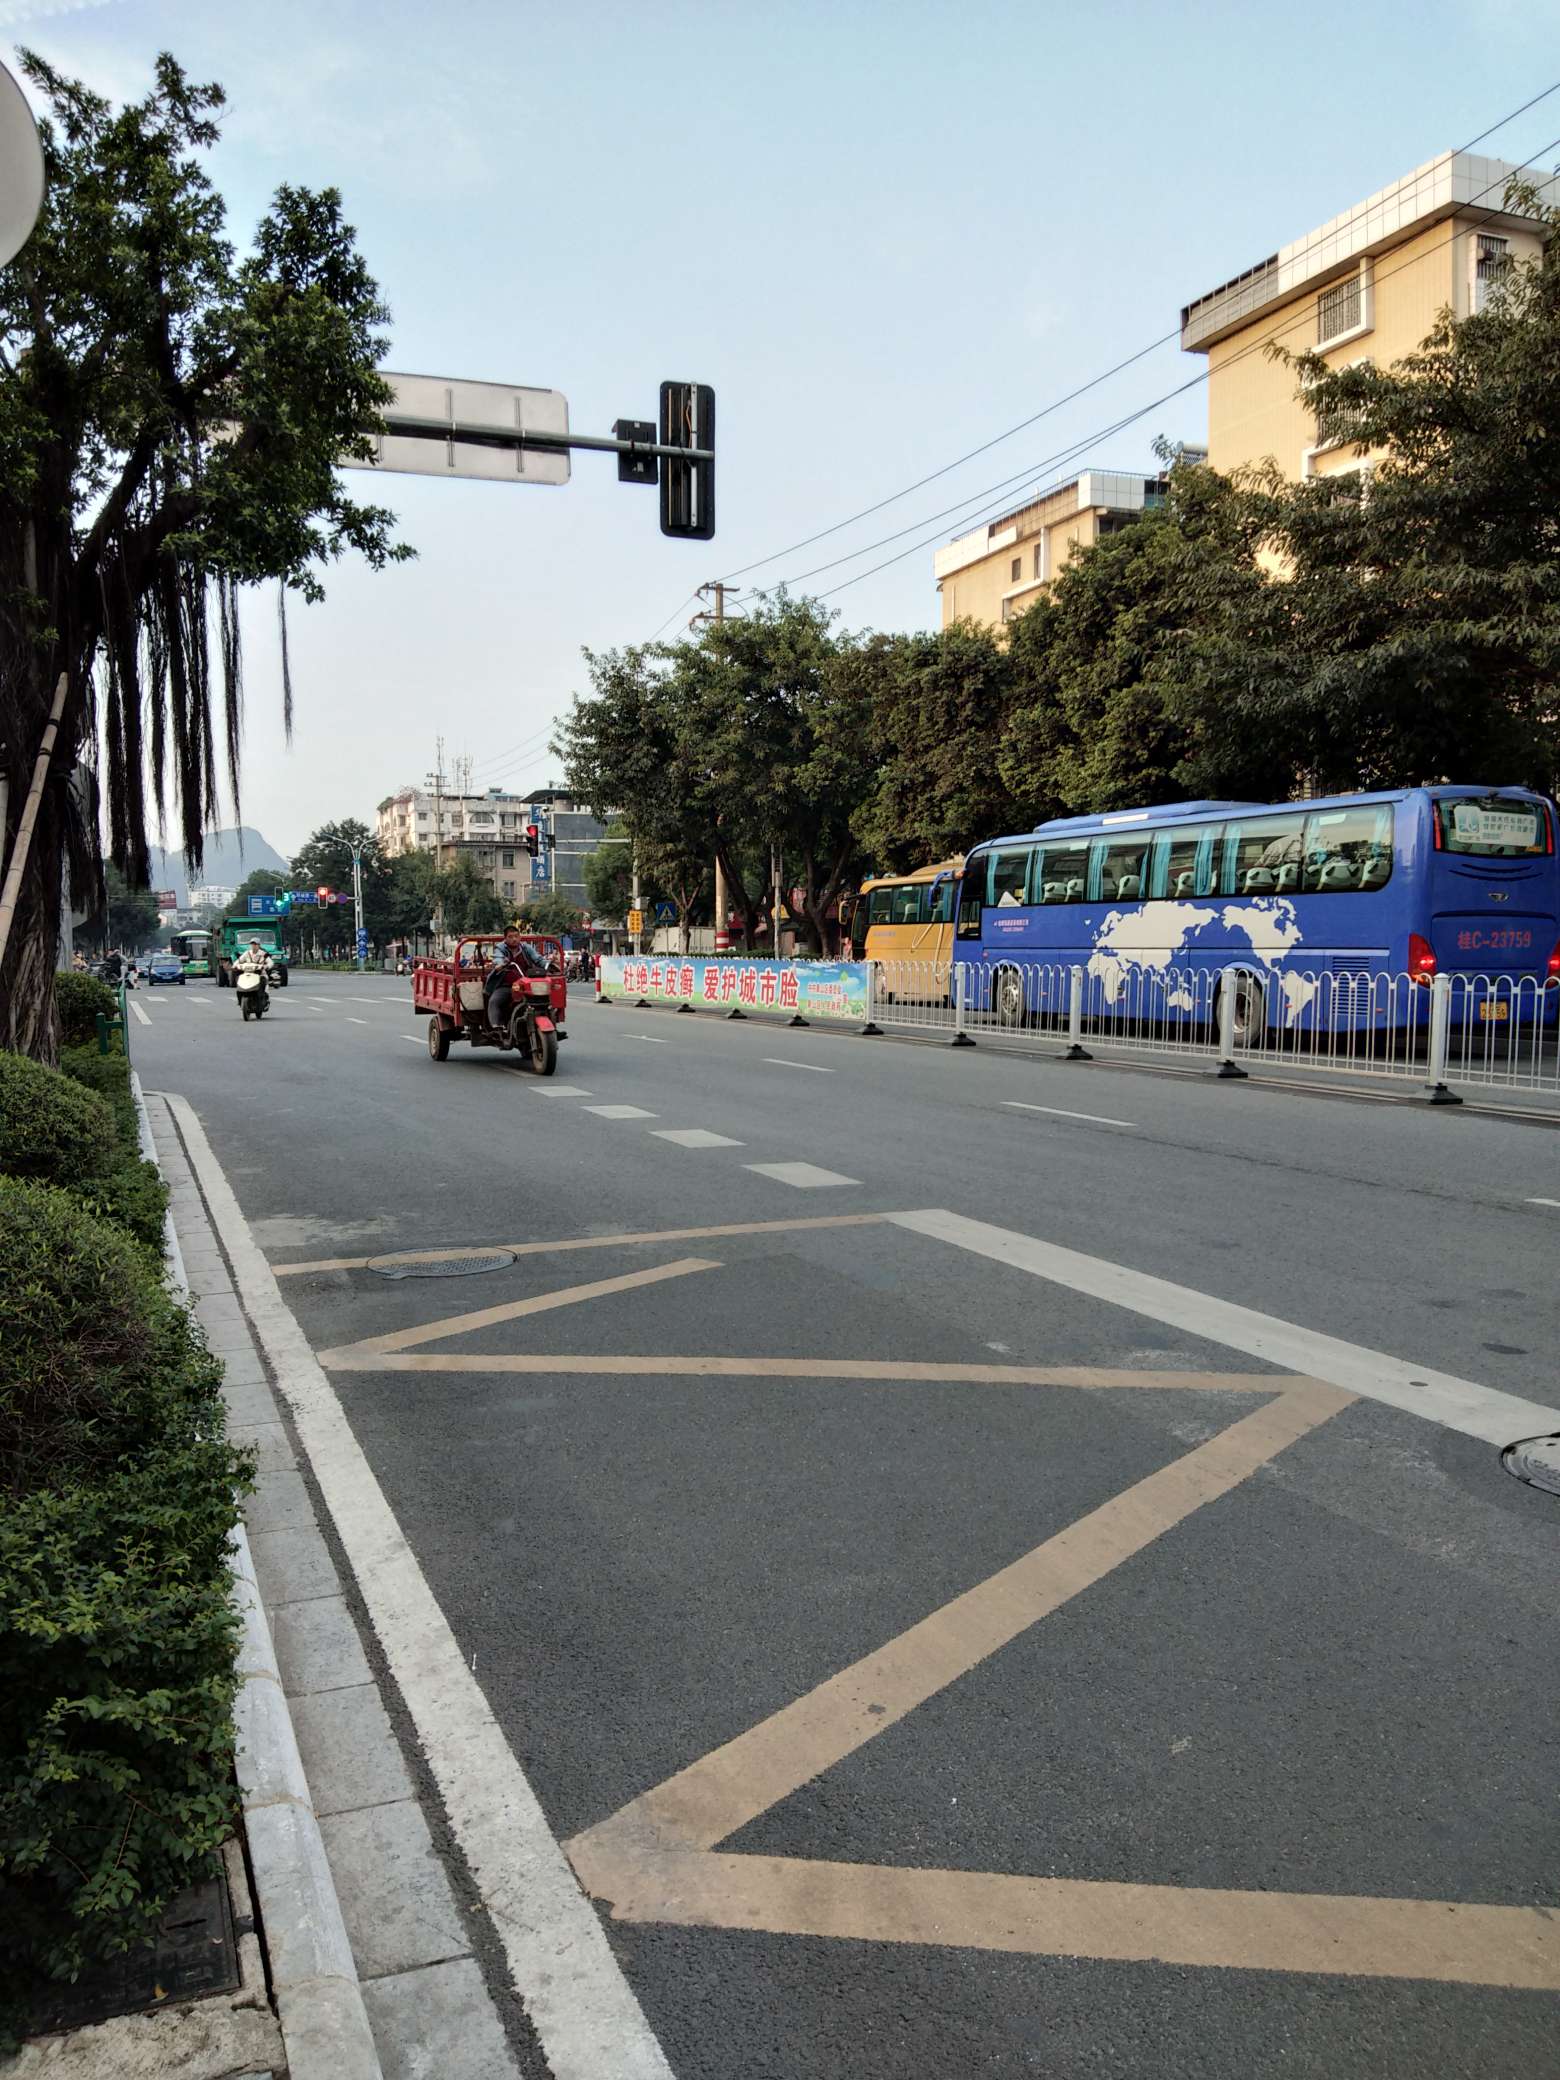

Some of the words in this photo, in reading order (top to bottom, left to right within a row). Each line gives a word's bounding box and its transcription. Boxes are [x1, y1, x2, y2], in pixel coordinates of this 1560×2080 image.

[1457, 930, 1532, 950] 桂C-23759
[623, 964, 694, 999] 杜绝牛皮癣
[704, 967, 799, 1007] 爱护城市脸
